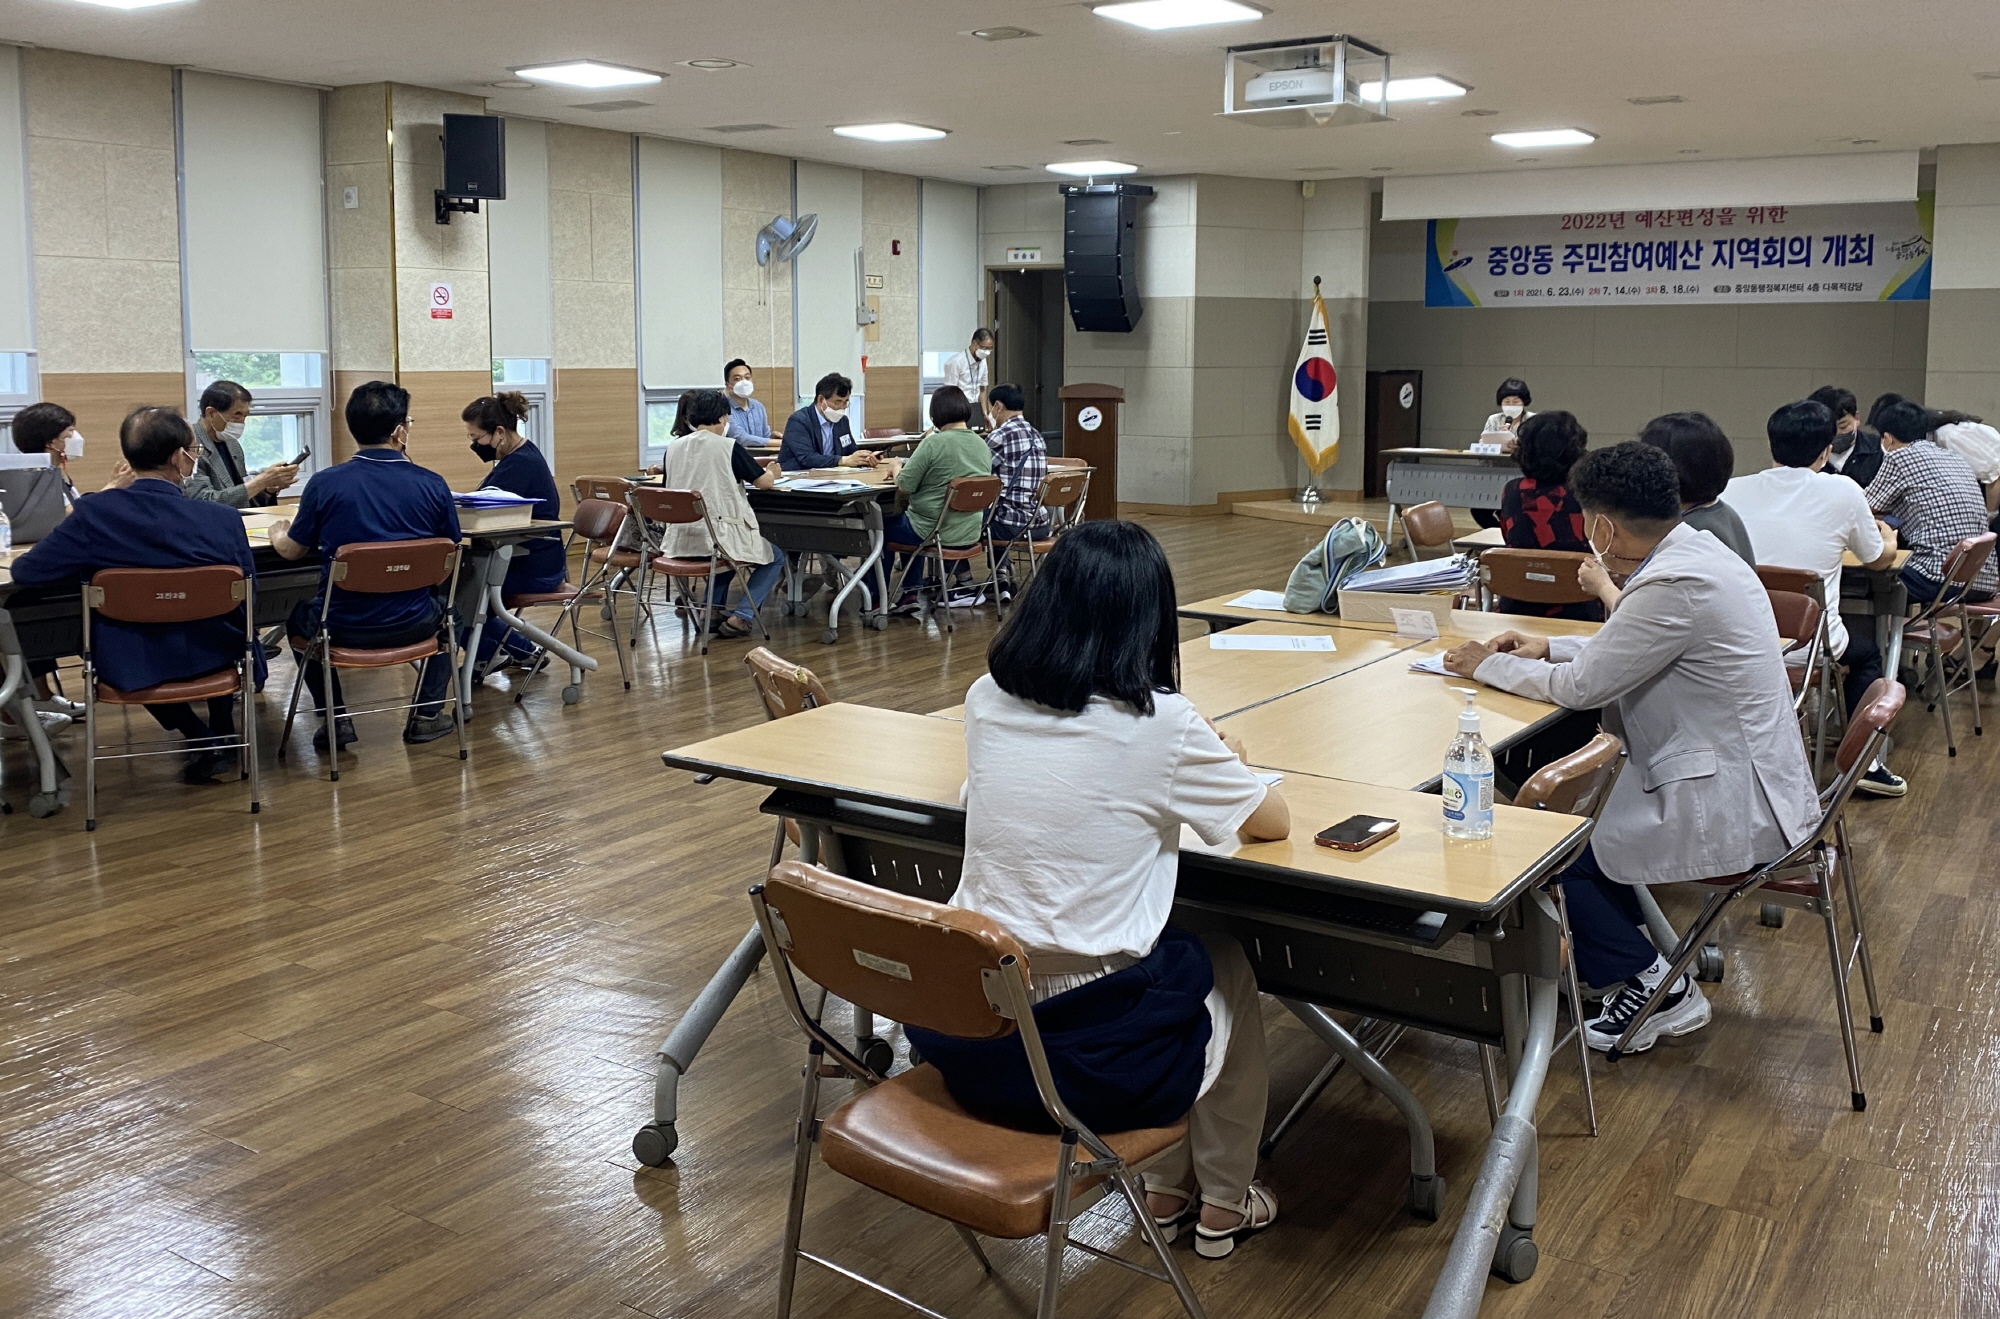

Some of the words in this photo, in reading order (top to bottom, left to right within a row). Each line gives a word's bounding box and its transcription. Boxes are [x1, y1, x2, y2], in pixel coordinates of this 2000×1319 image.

[1269, 80, 1303, 91] EPSON
[1561, 213, 1625, 230] 2022년
[1635, 207, 1736, 228] 예산편성을
[1747, 206, 1788, 224] 위한
[1488, 244, 1554, 276] 중앙동
[1562, 239, 1703, 274] 주민참여예산
[1712, 235, 1812, 270] 지역회의
[1822, 233, 1874, 267] 개최
[1526, 289, 1545, 297] 2021.
[1547, 287, 1556, 297] 6.
[1603, 287, 1611, 296] 7.
[1660, 285, 1669, 295] 8.
